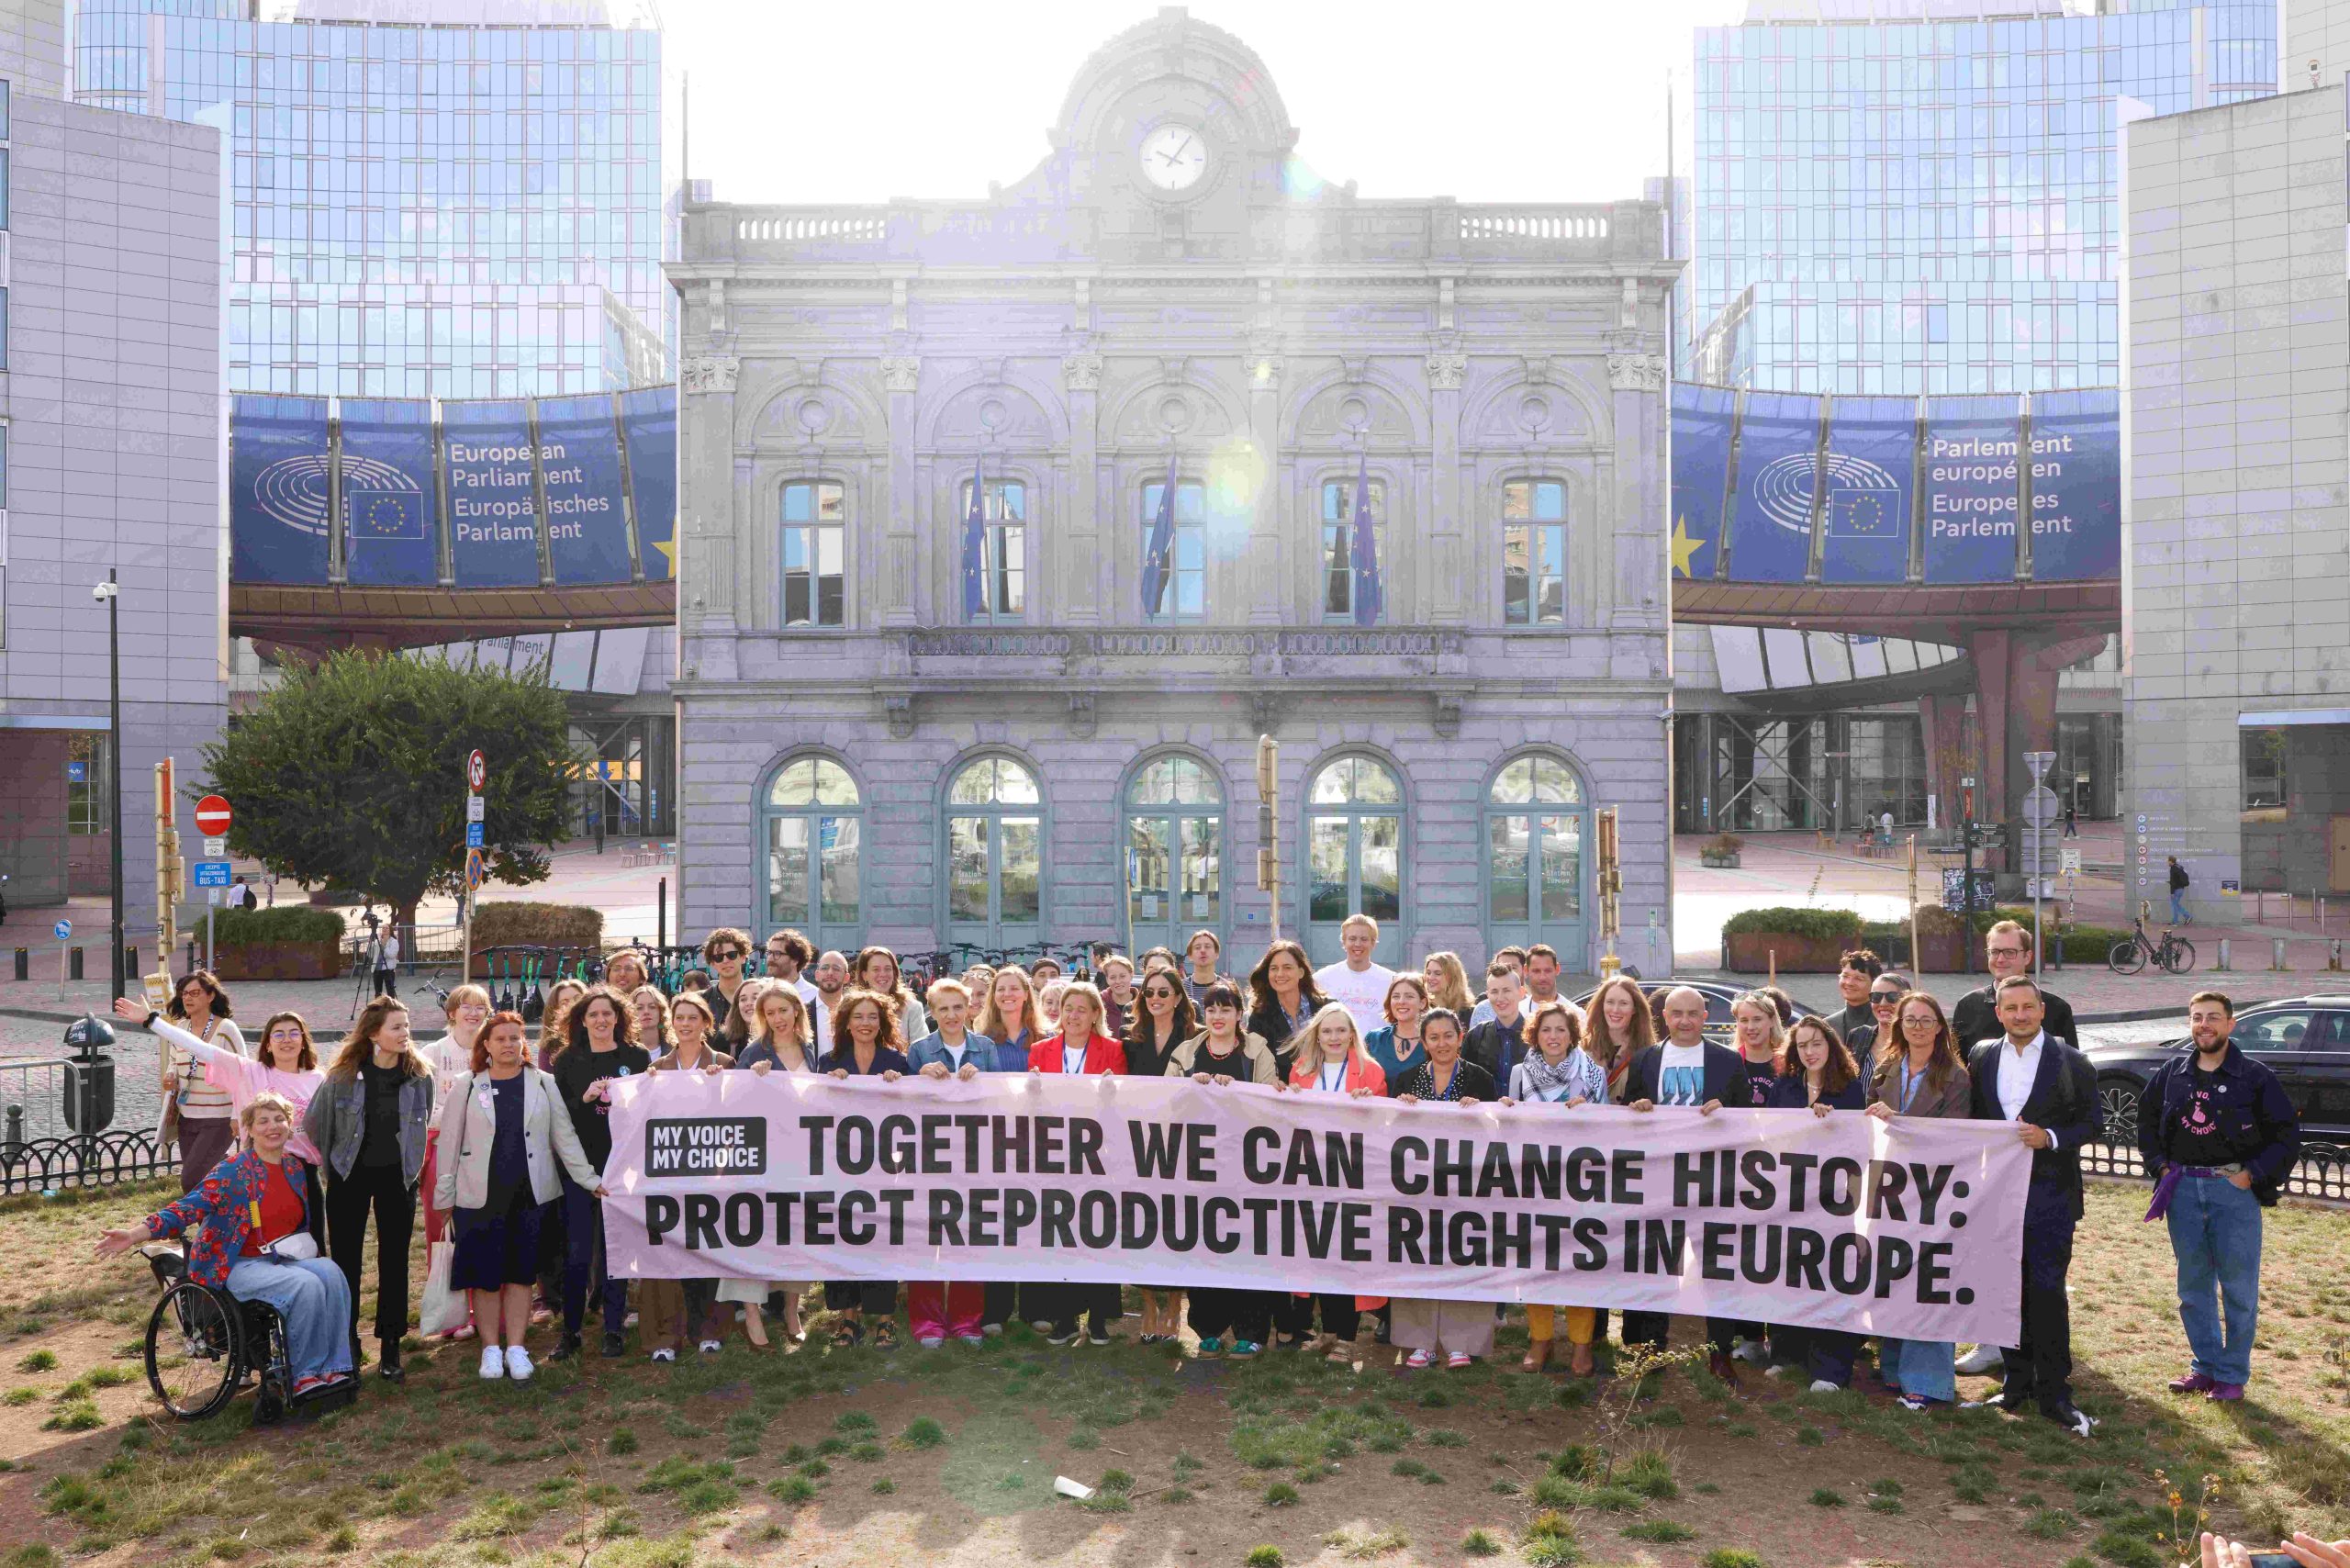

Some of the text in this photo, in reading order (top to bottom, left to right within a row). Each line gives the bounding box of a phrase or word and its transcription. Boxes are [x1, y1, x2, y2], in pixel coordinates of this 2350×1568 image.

[451, 443, 565, 465] European
[1933, 435, 2073, 458] Parlement
[1932, 460, 2061, 484] européen
[455, 494, 610, 520] Europäisches
[1932, 494, 2059, 515] Europees
[457, 521, 583, 542] Parlament
[1932, 516, 2072, 538] Parlement
[1752, 1077, 1774, 1089] VOICE
[653, 1125, 745, 1147] MY VOICE
[2191, 1120, 2217, 1135] CHOIC
[653, 1147, 759, 1170] MY CHOICE
[800, 1114, 1971, 1228] TOGETHER WE CAN CHANGE HISTORY:
[644, 1188, 1975, 1305] PROTECT REPRODUCTIVE RIGHTS IN EUROPE.
